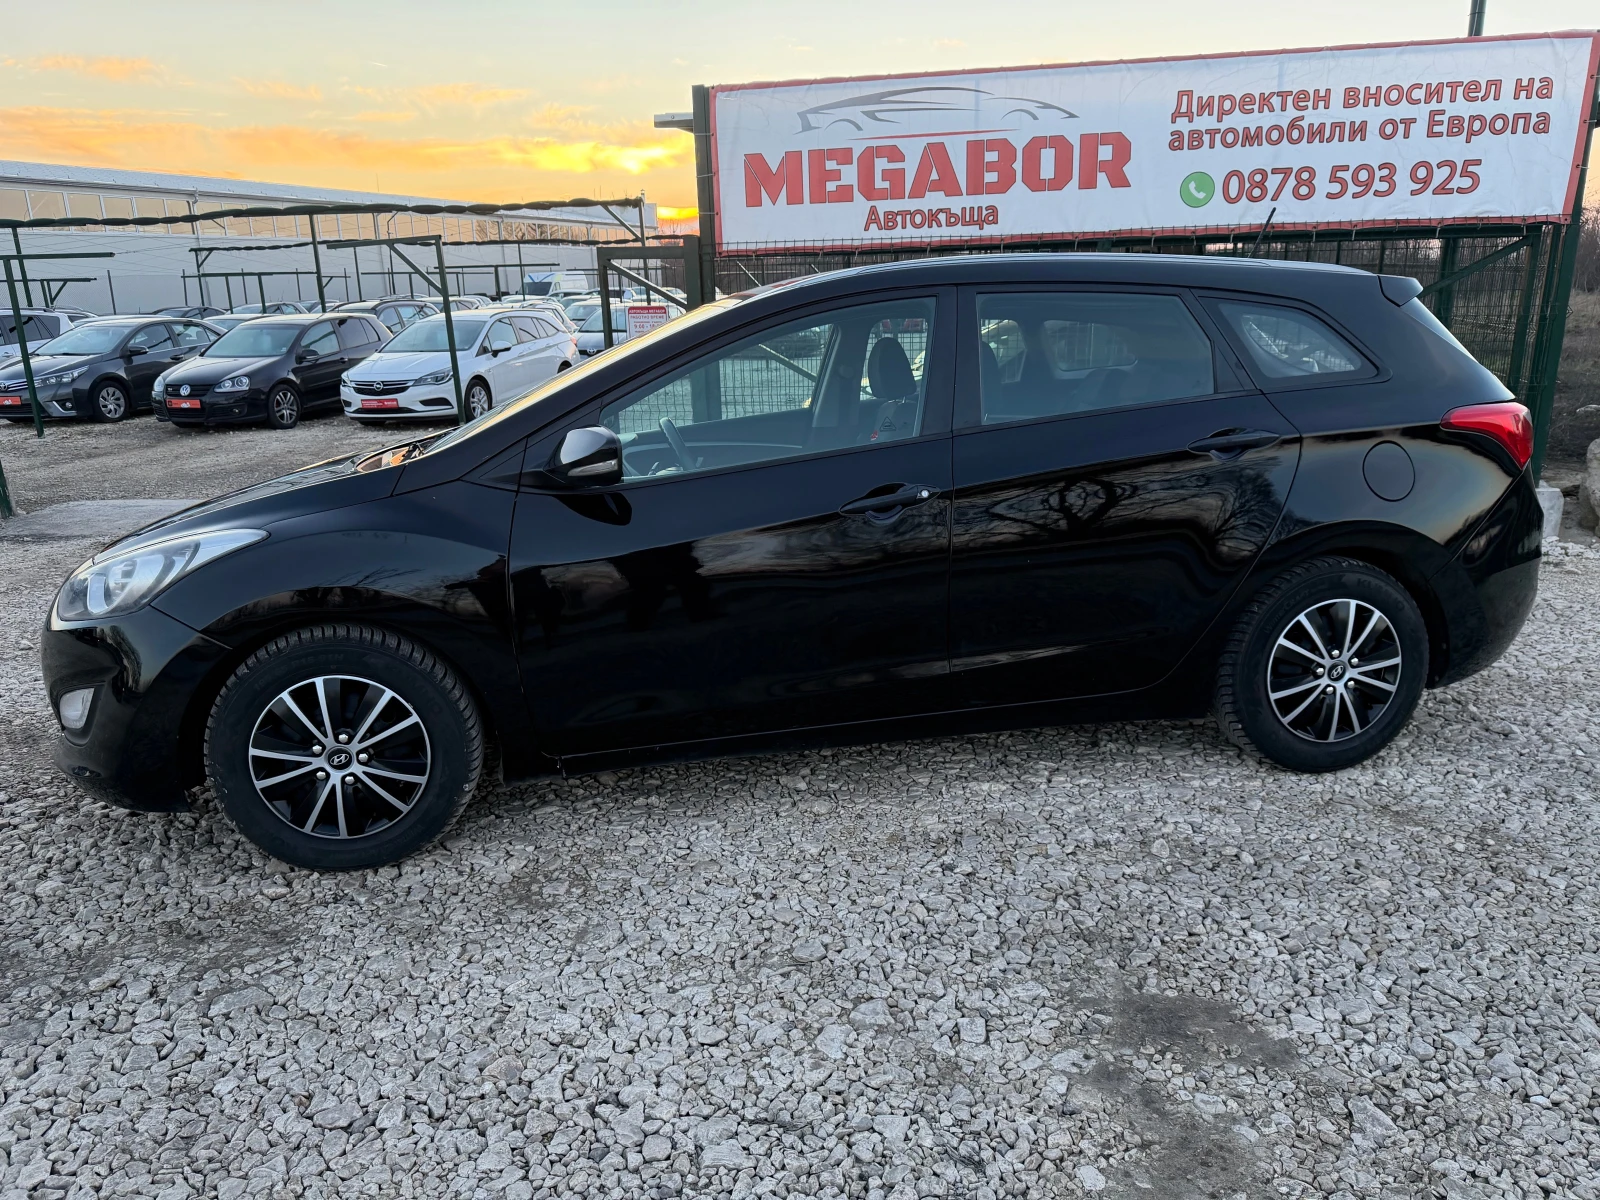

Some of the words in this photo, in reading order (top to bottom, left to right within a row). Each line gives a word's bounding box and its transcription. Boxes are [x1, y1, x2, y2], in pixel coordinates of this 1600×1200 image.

[1171, 89, 1332, 124] Директен
[1343, 78, 1502, 109] вносител
[1513, 76, 1553, 100] на
[1168, 115, 1368, 151] автомобили
[1378, 117, 1417, 140] от
[1426, 109, 1551, 144] Европа
[743, 131, 1132, 208] MEGABOR
[1222, 166, 1316, 204] 0878
[1325, 162, 1397, 200] 593
[1409, 158, 1483, 196] 925
[863, 204, 999, 232] Автокъща
